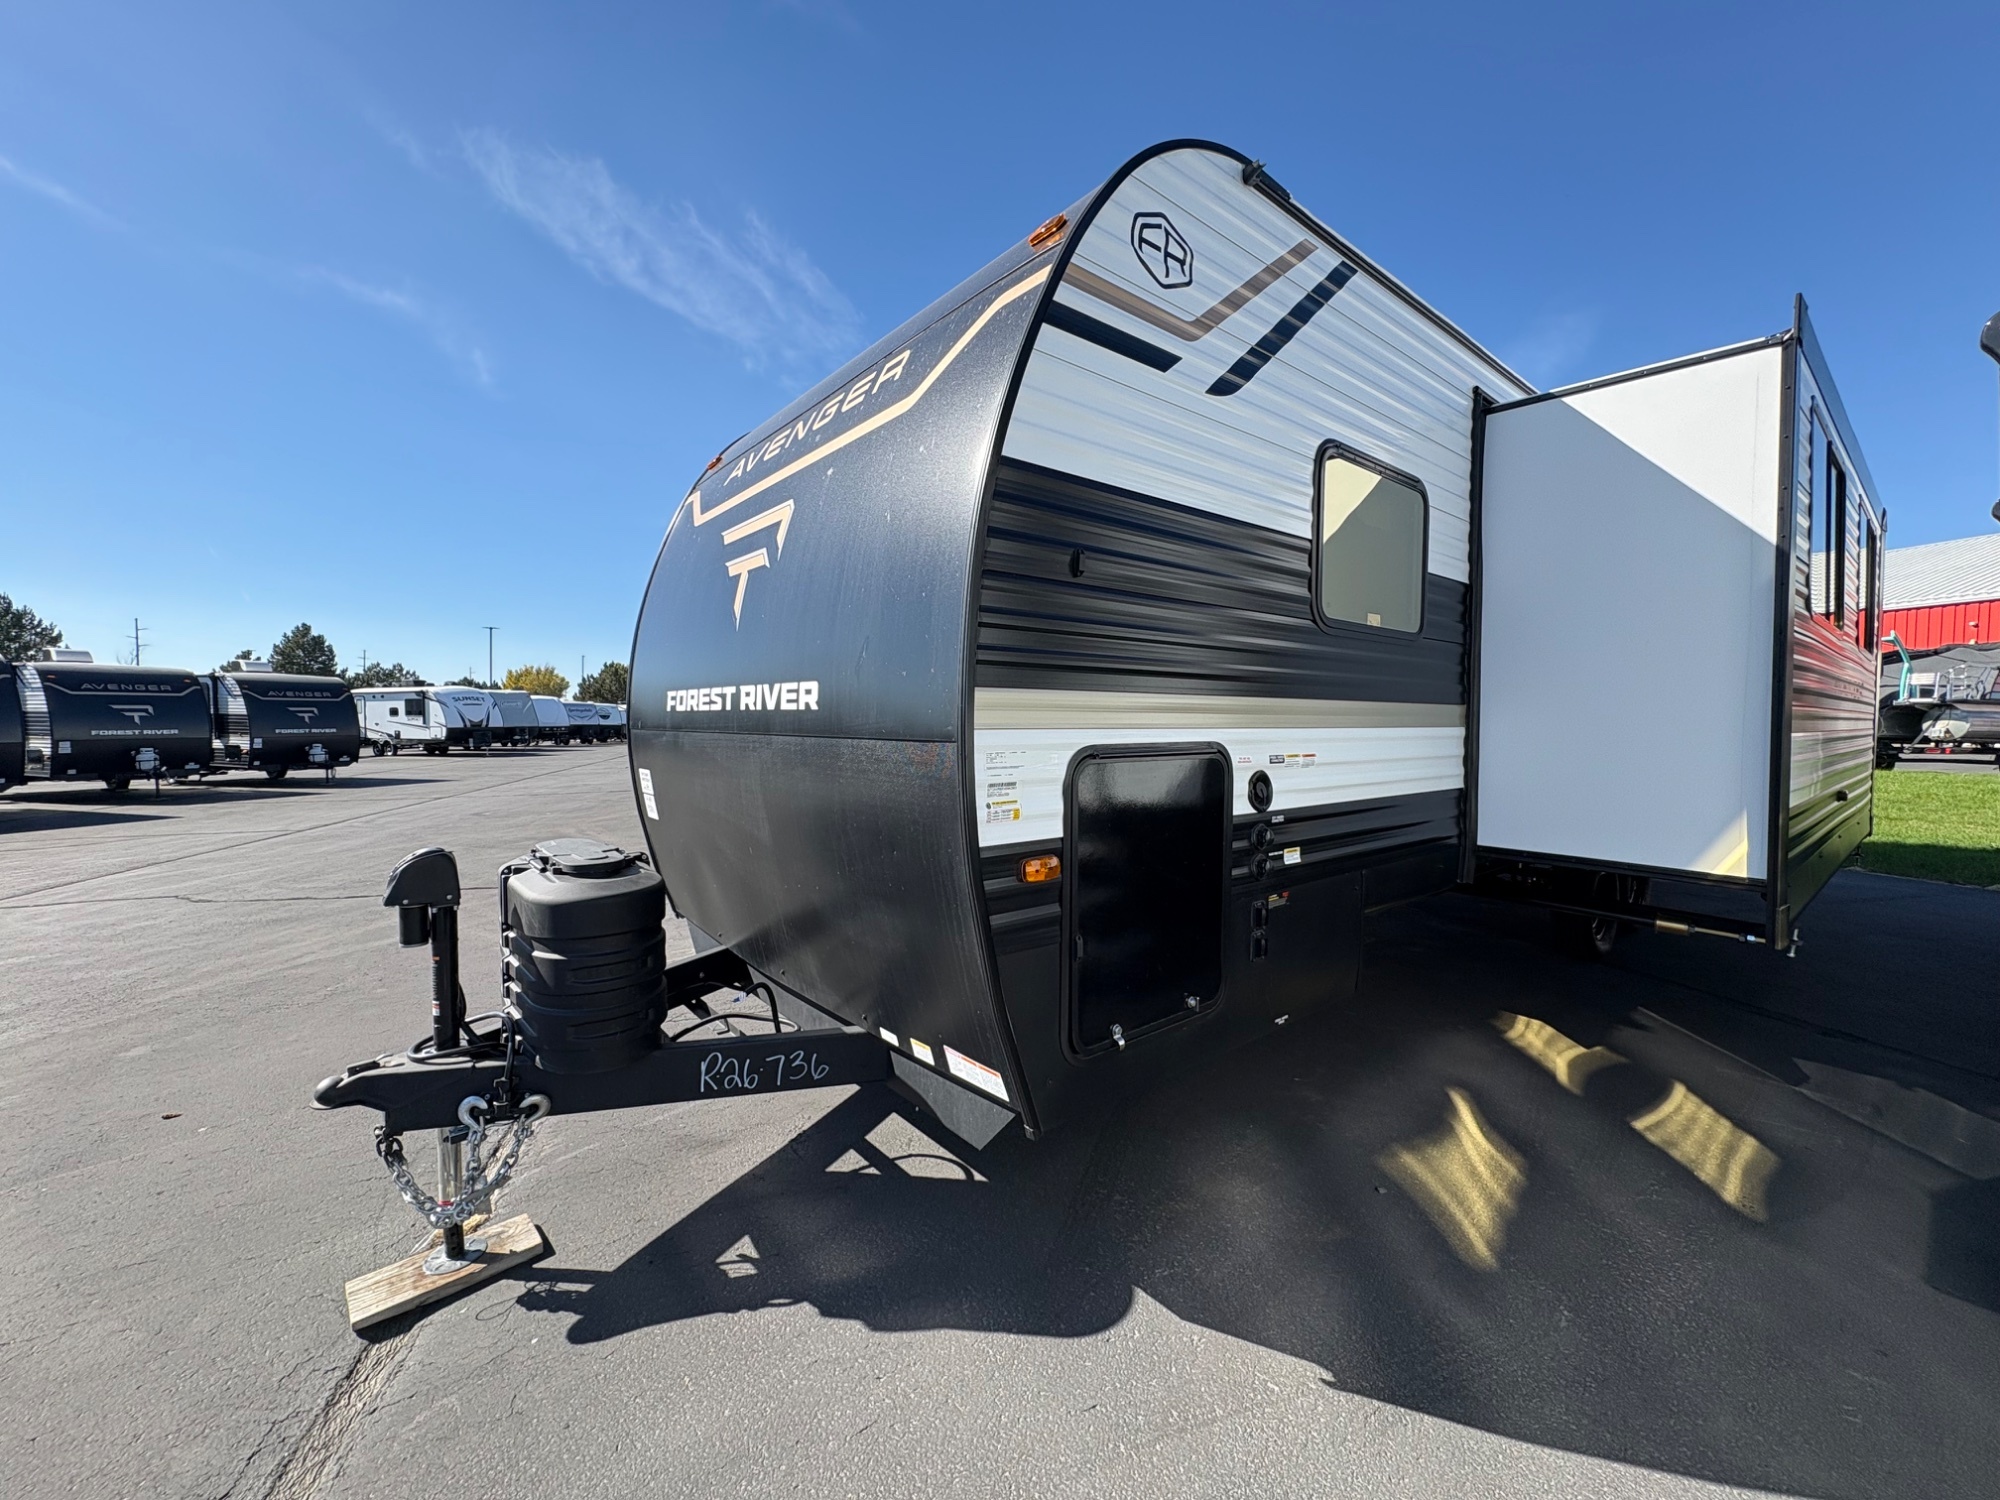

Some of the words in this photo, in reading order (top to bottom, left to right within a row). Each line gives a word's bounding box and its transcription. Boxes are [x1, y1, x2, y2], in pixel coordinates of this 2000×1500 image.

[723, 349, 911, 487] AVENGER
[80, 683, 172, 691] AVENGER
[666, 686, 737, 712] FOREST
[739, 680, 819, 711] RIVER
